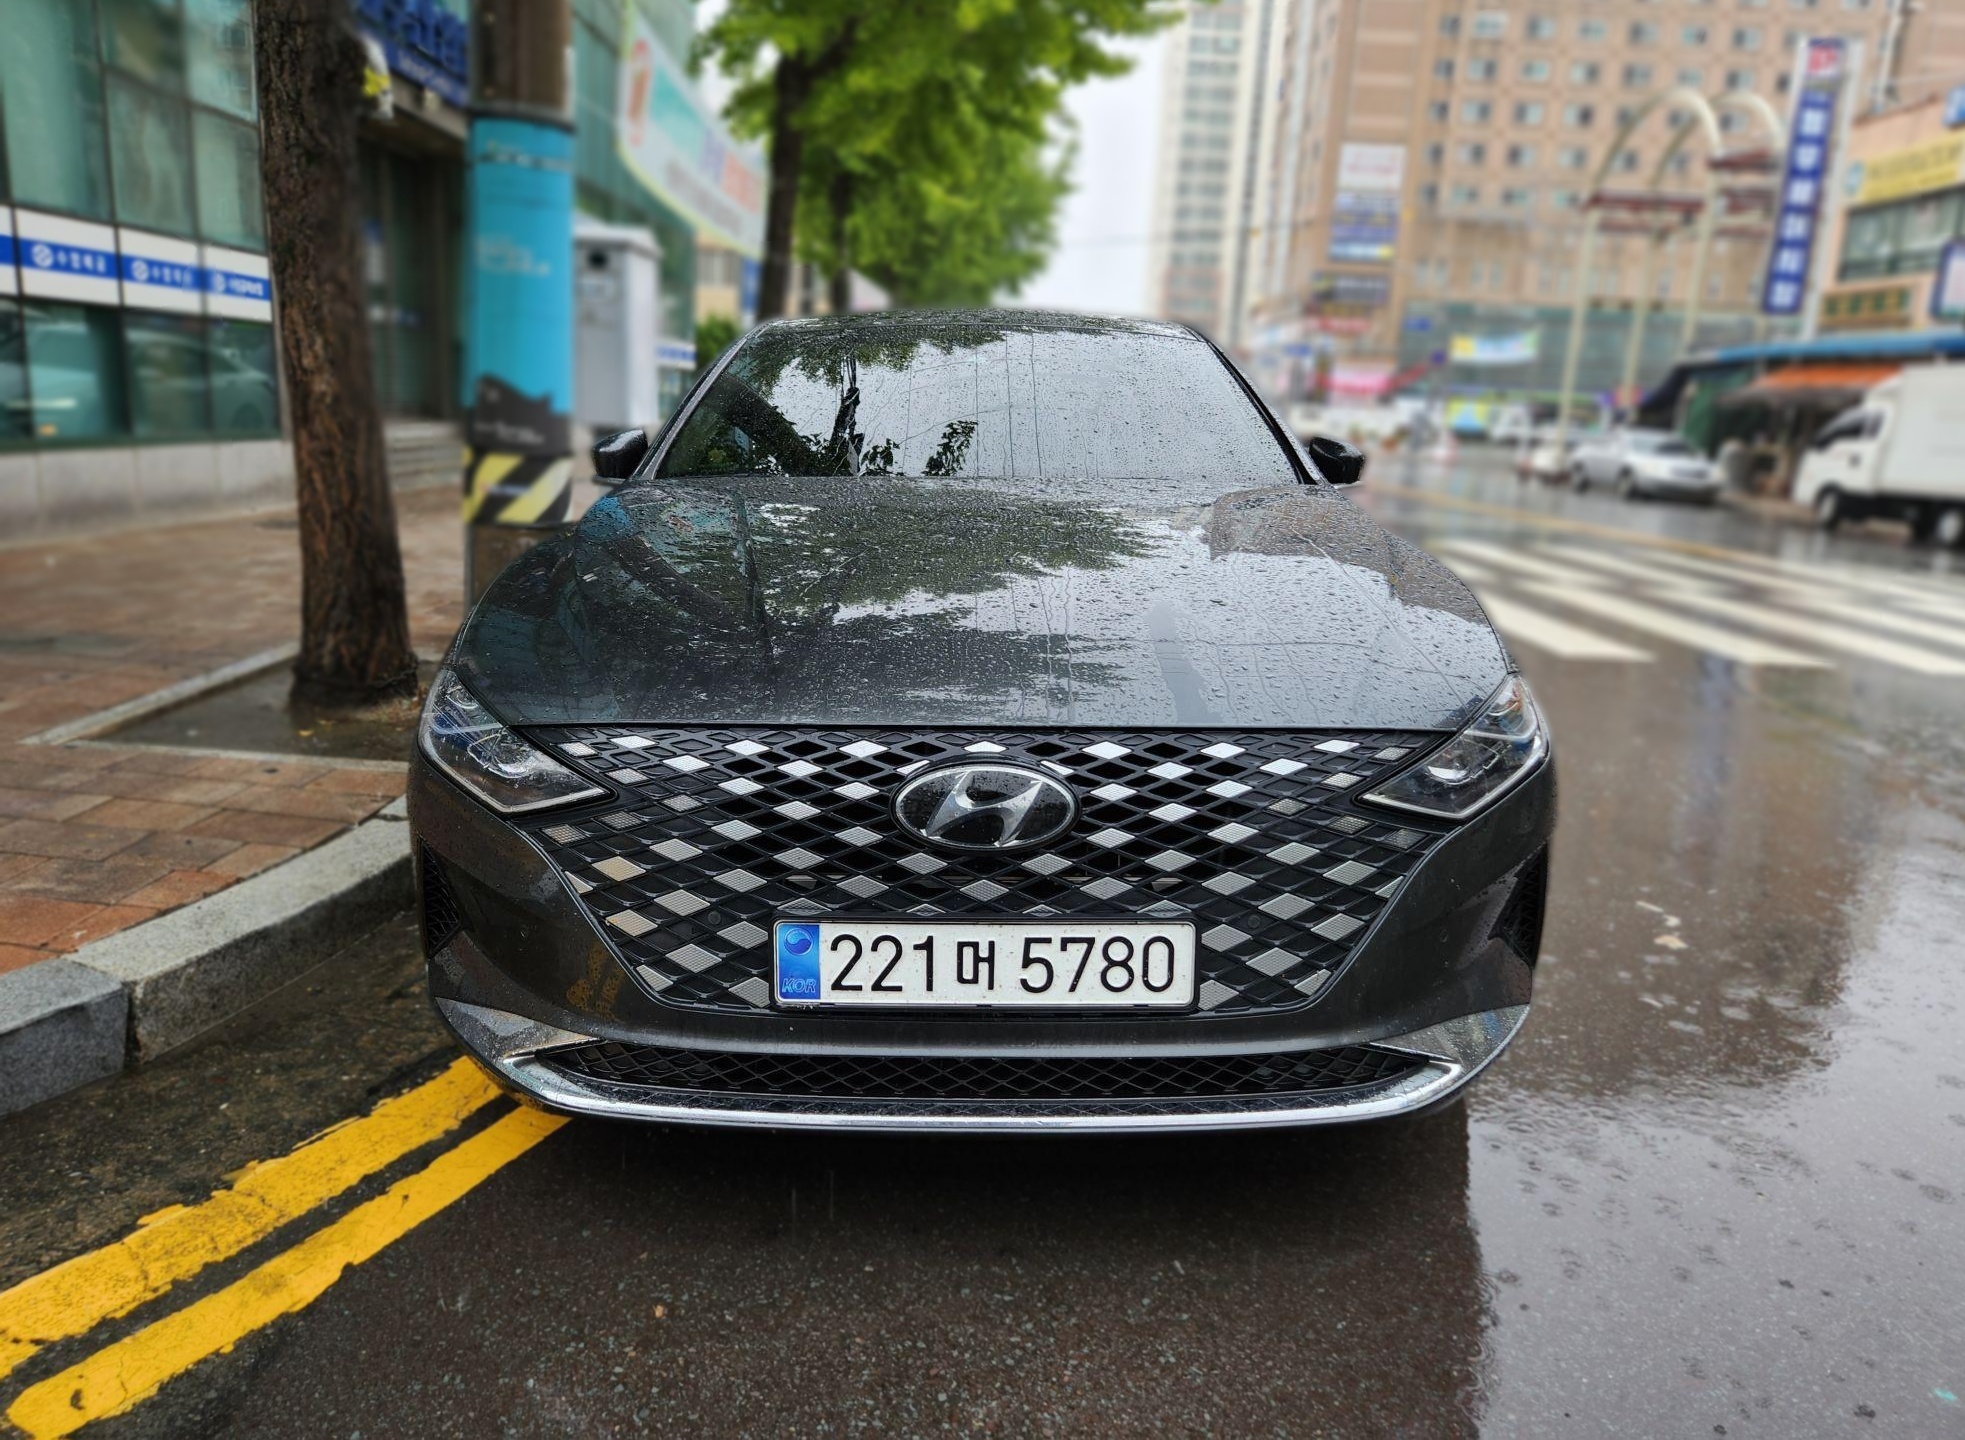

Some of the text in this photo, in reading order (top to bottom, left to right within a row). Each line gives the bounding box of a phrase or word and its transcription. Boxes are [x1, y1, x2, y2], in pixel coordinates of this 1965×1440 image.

[831, 934, 1174, 993] 221 머 5780
[782, 978, 817, 993] KOR
